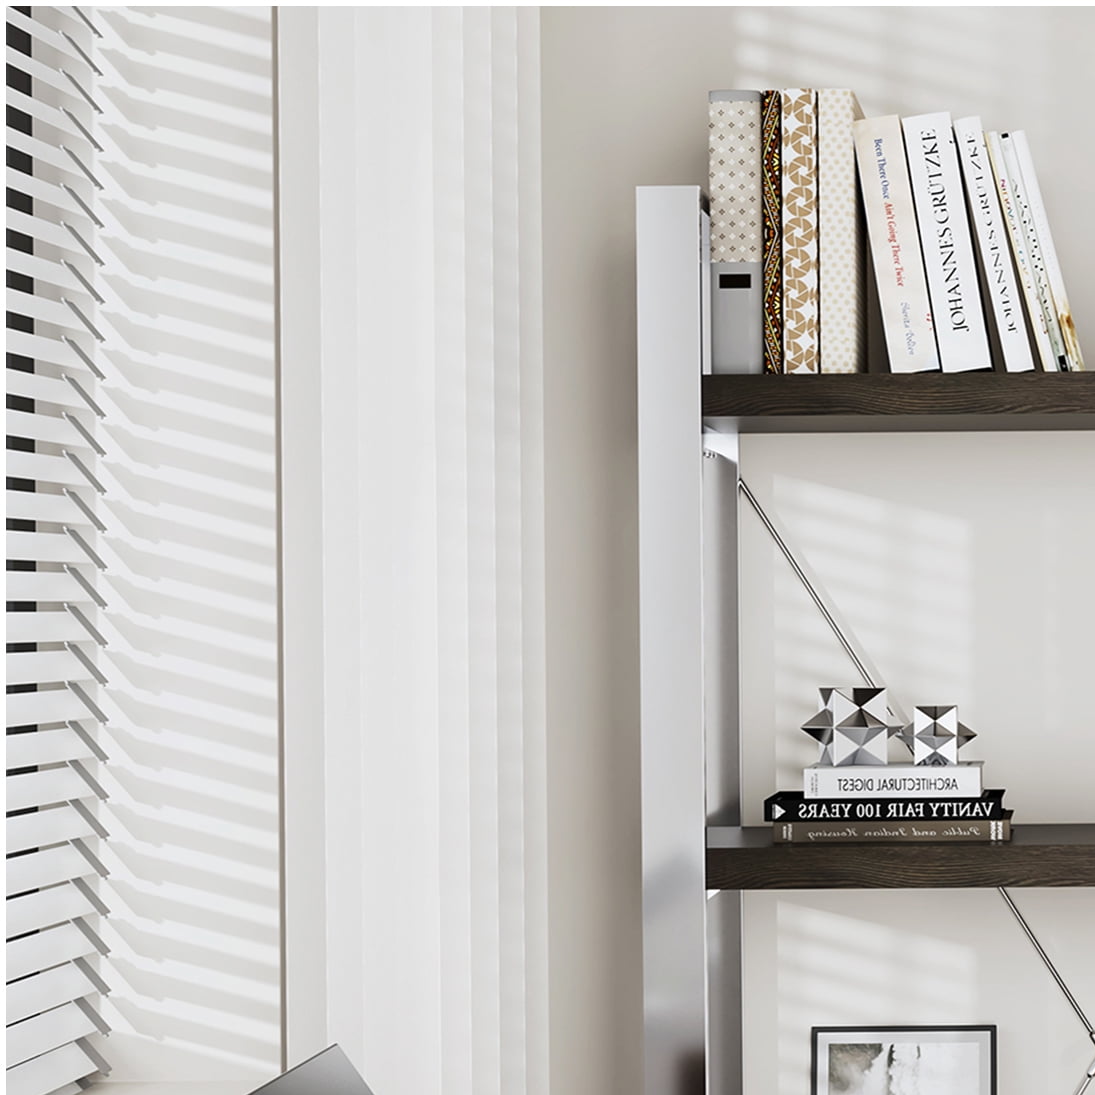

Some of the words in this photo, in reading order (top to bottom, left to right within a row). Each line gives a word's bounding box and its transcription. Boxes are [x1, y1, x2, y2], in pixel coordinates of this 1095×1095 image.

[873, 138, 884, 157] Been
[876, 158, 888, 179] There
[920, 128, 949, 225] GRÜTZKE
[880, 180, 891, 200] Once
[884, 202, 895, 220] Ain't
[885, 221, 899, 244] Going
[890, 244, 902, 265] There
[894, 267, 905, 287] Twice
[936, 226, 970, 333] JOHANNES
